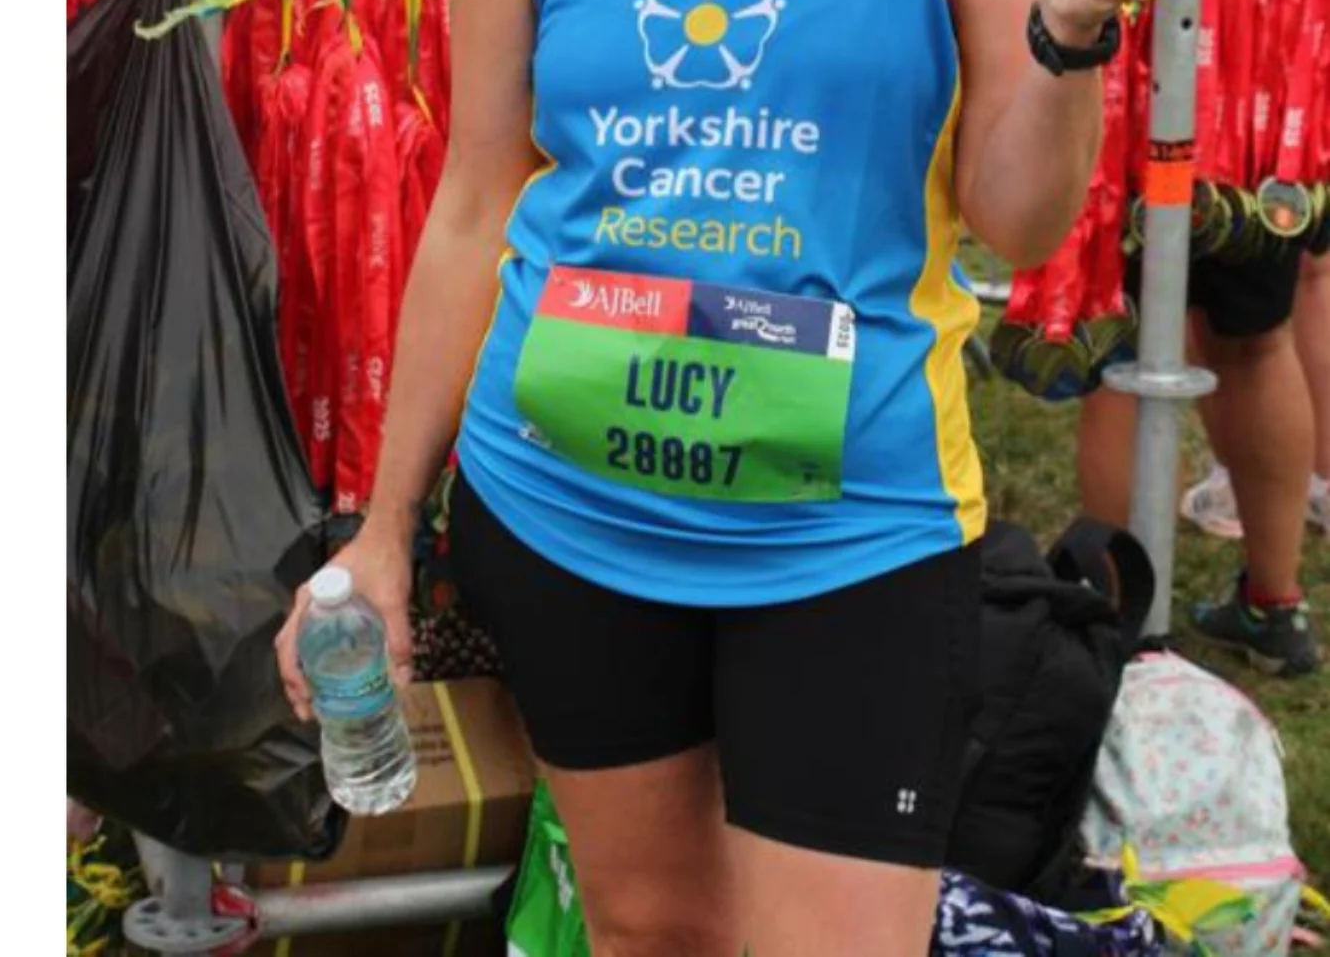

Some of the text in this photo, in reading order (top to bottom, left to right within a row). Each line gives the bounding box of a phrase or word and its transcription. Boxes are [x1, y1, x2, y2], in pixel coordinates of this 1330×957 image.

[588, 105, 820, 154] Yorkshire
[611, 157, 785, 203] Cancer
[594, 205, 802, 260] Research
[626, 354, 736, 419] LUCY
[606, 426, 743, 486] 28887
